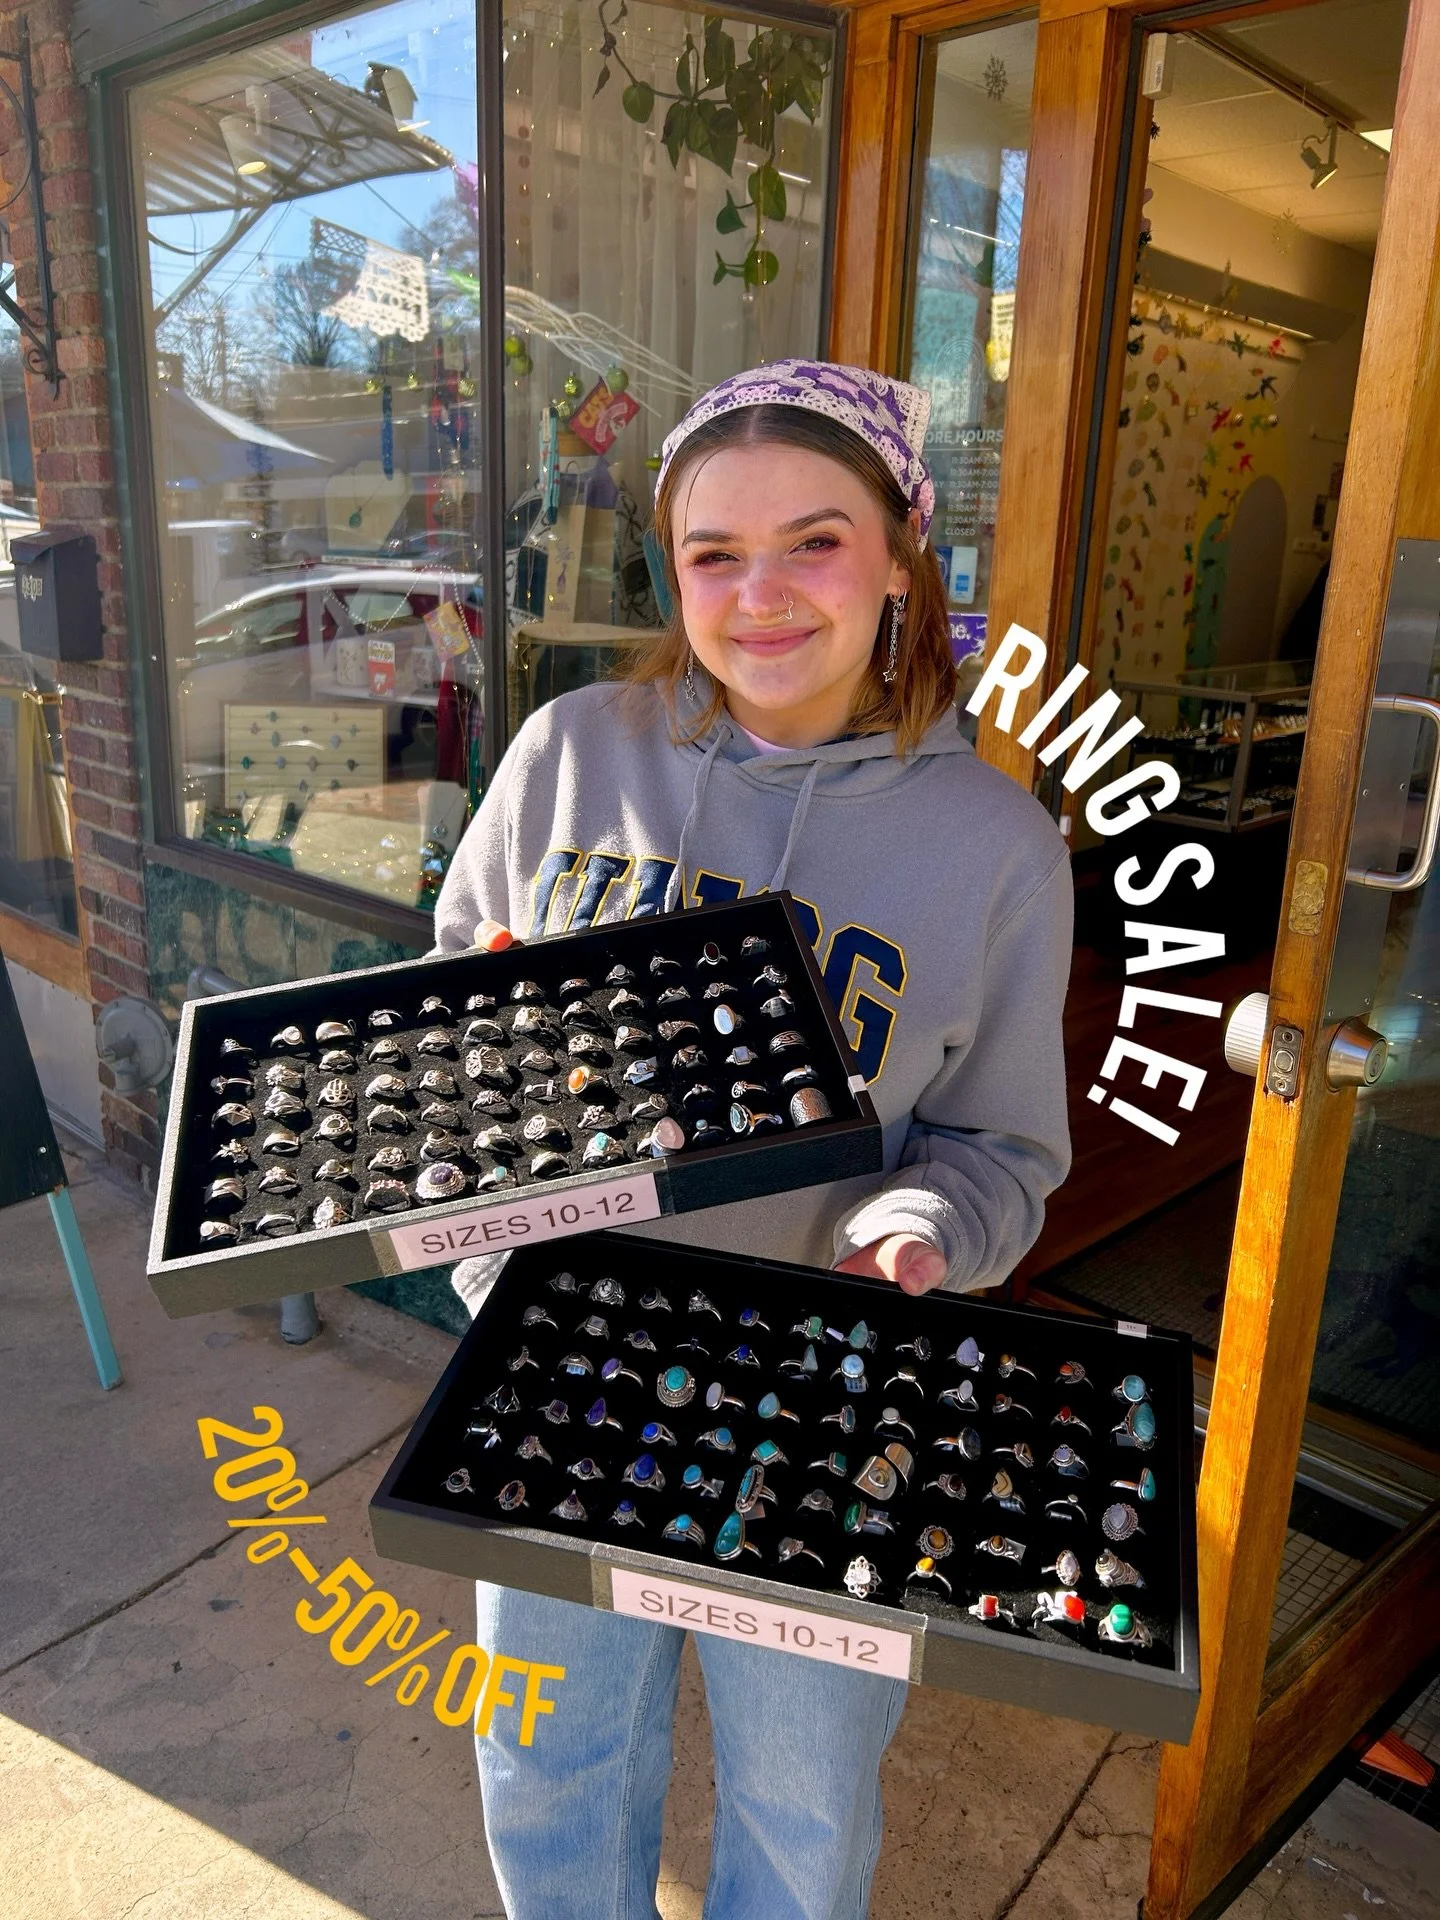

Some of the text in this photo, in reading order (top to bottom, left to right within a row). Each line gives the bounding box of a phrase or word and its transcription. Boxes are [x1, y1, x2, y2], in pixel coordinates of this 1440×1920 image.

[924, 429, 1004, 444] ORE HOURS
[944, 527, 976, 536] CLOSED
[420, 1191, 636, 1255] SIZES 10-12
[639, 1589, 880, 1665] SIZES 10-12
